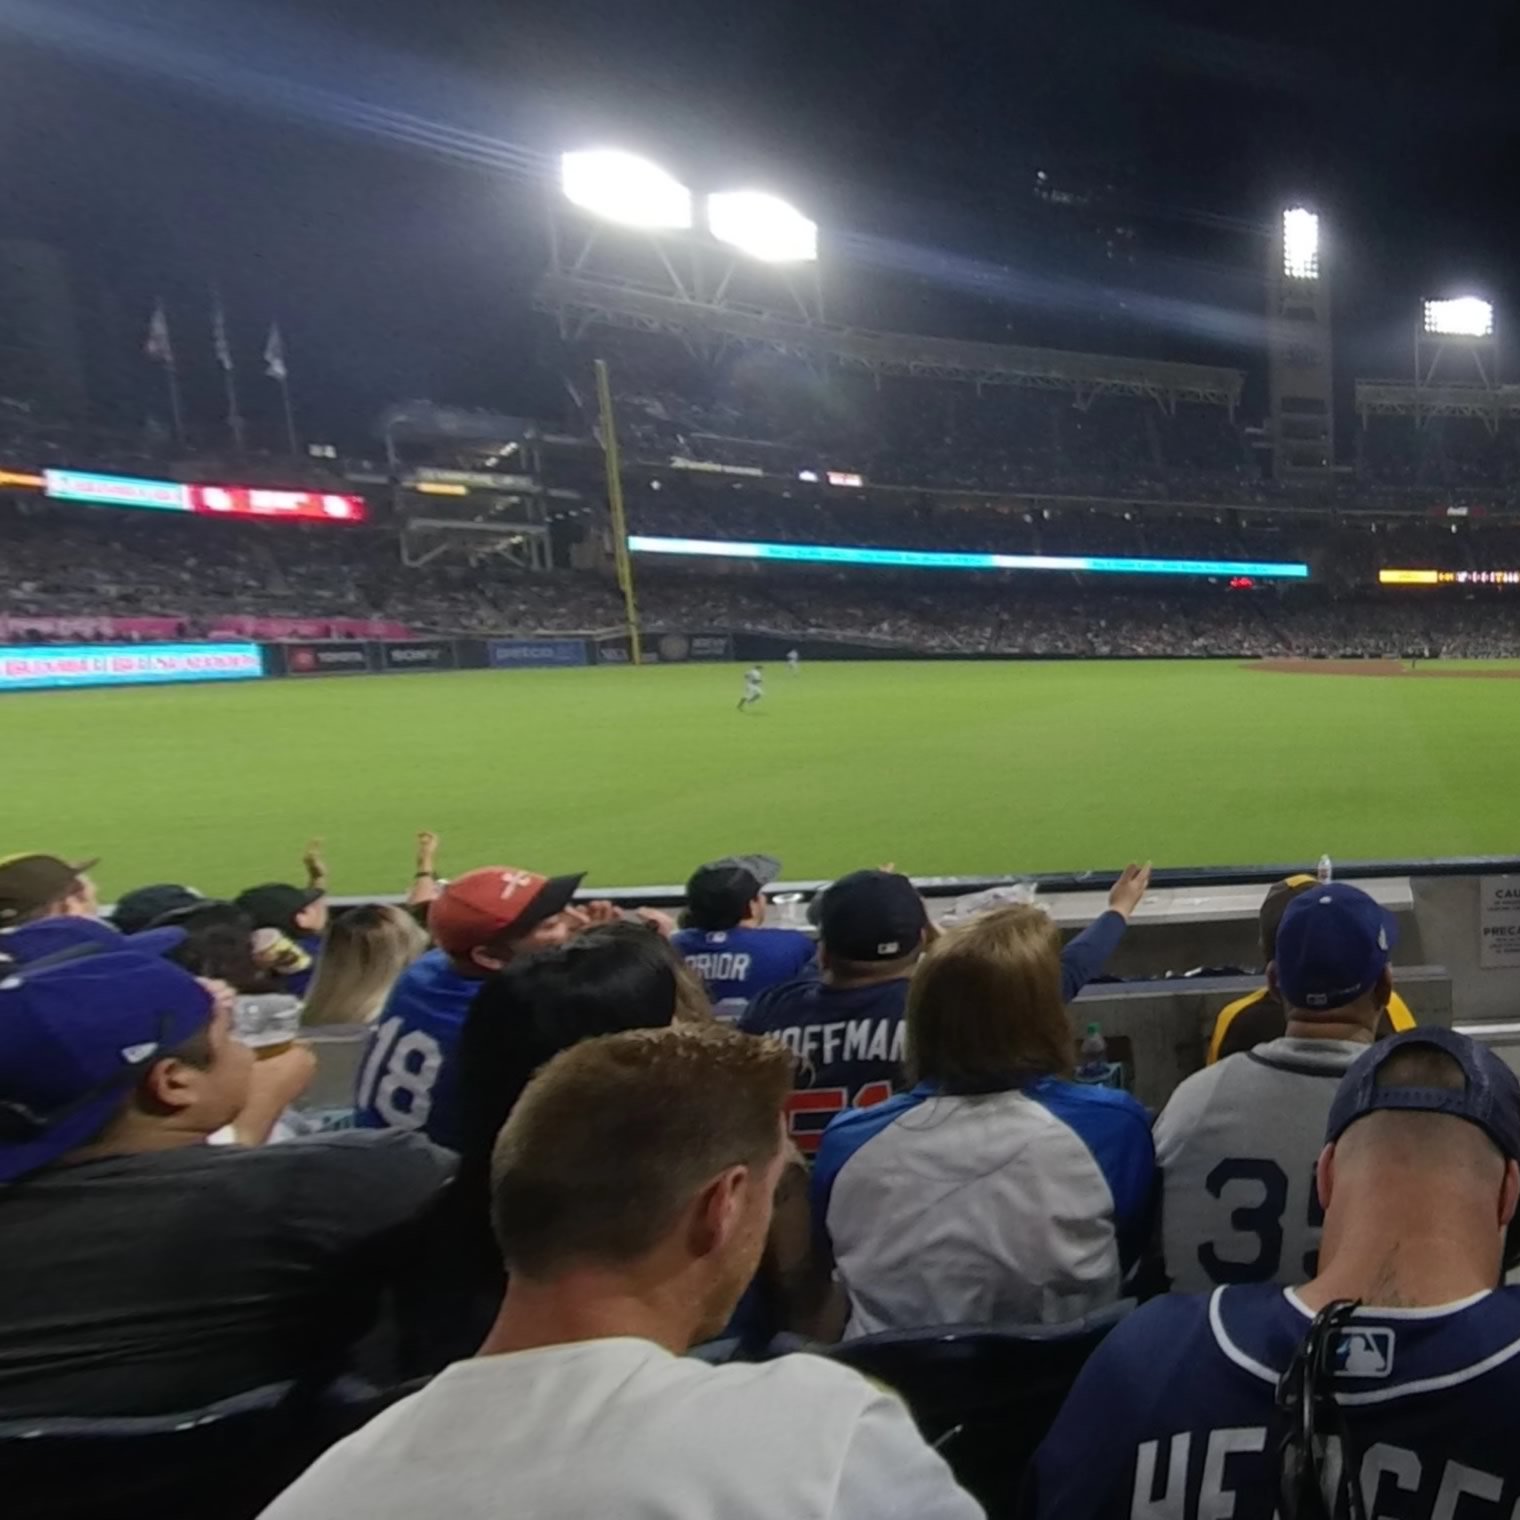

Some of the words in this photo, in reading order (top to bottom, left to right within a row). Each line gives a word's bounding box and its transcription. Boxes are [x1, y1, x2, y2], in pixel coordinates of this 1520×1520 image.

[358, 1015, 443, 1128] 18
[764, 1018, 907, 1065] OFFMAN
[1197, 1157, 1325, 1284] 3
